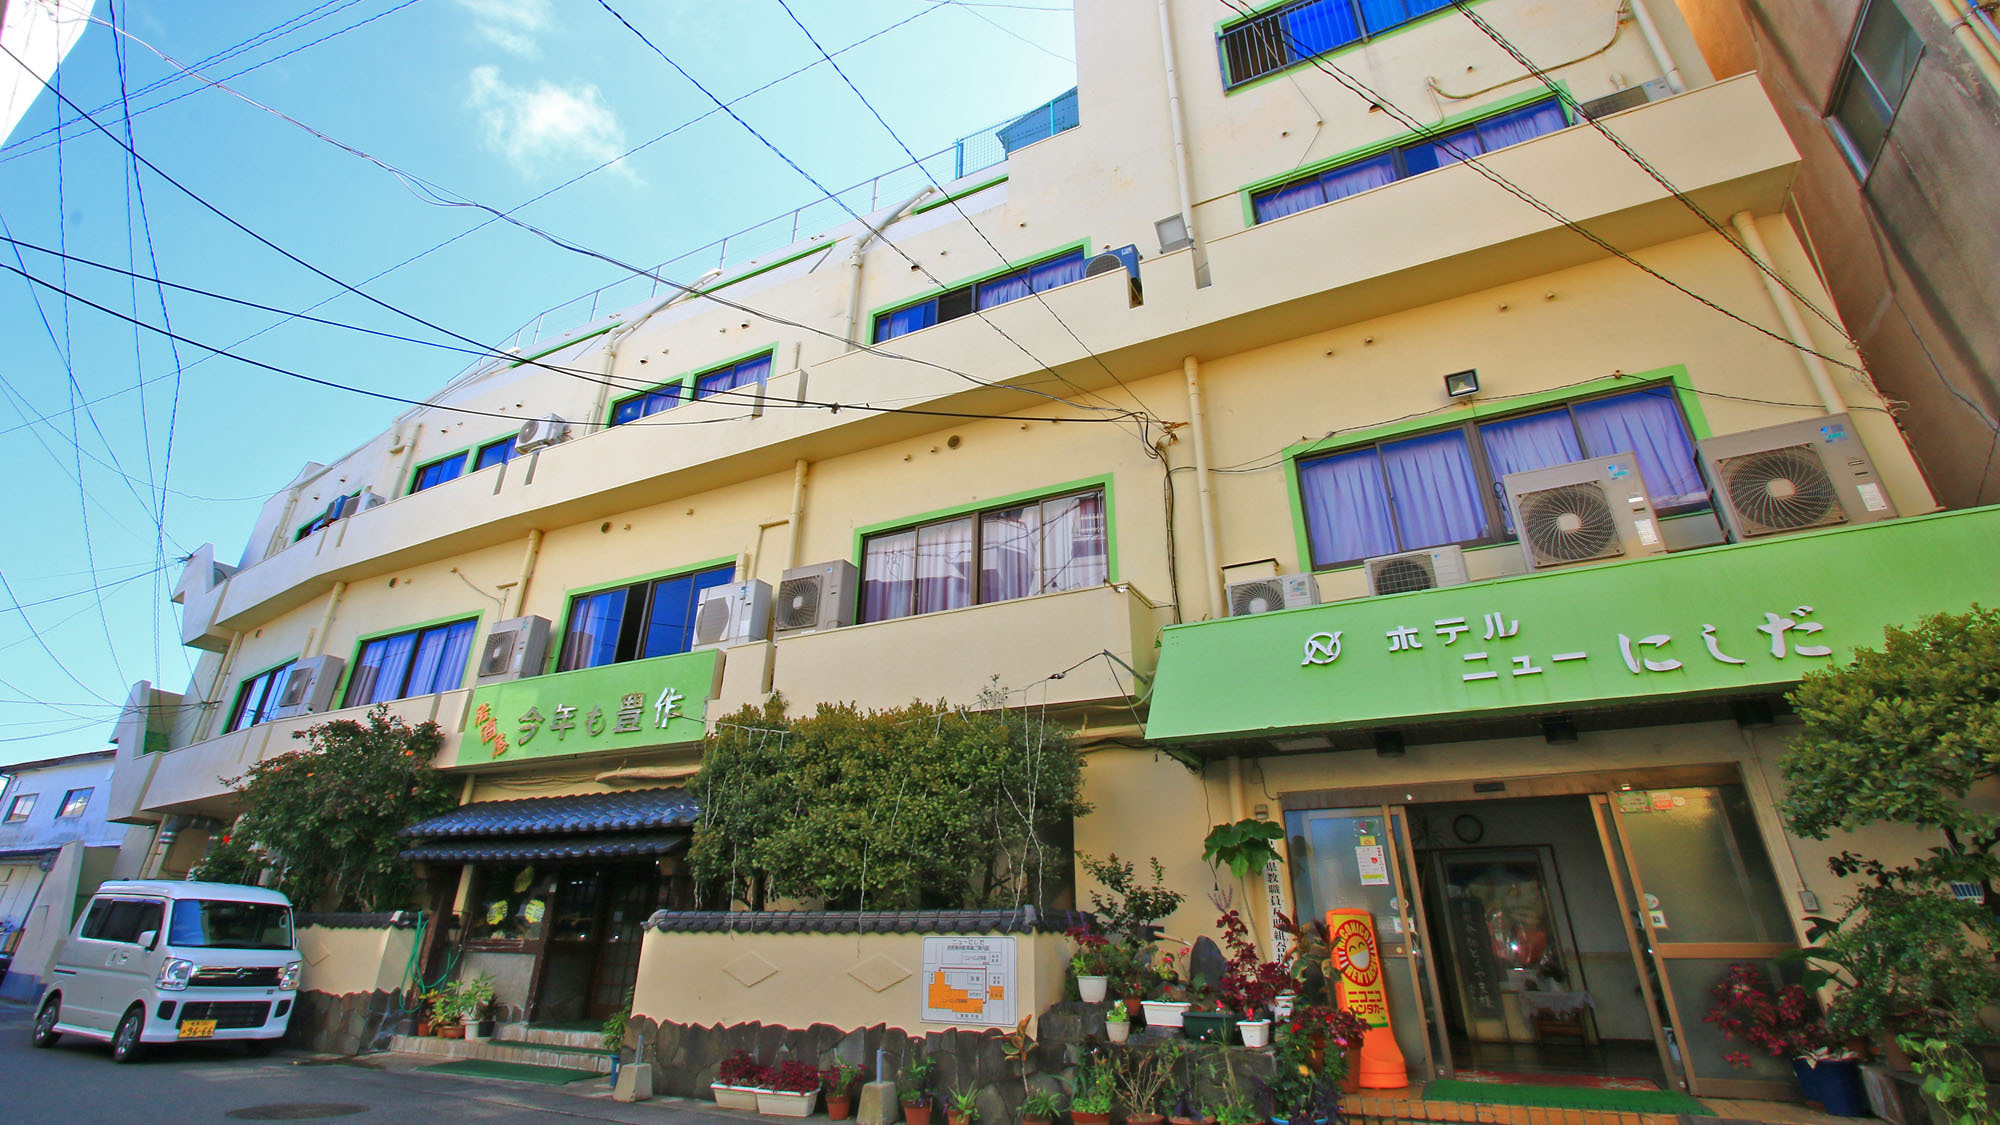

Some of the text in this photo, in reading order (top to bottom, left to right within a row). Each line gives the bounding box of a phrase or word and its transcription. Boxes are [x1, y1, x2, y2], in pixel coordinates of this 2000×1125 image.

[1386, 611, 1519, 653] ホテル
[1618, 605, 1833, 675] にしだ
[474, 702, 510, 759] 居酒屋
[518, 687, 686, 746] 今年も豊作
[1348, 990, 1382, 1003] ニコニコ
